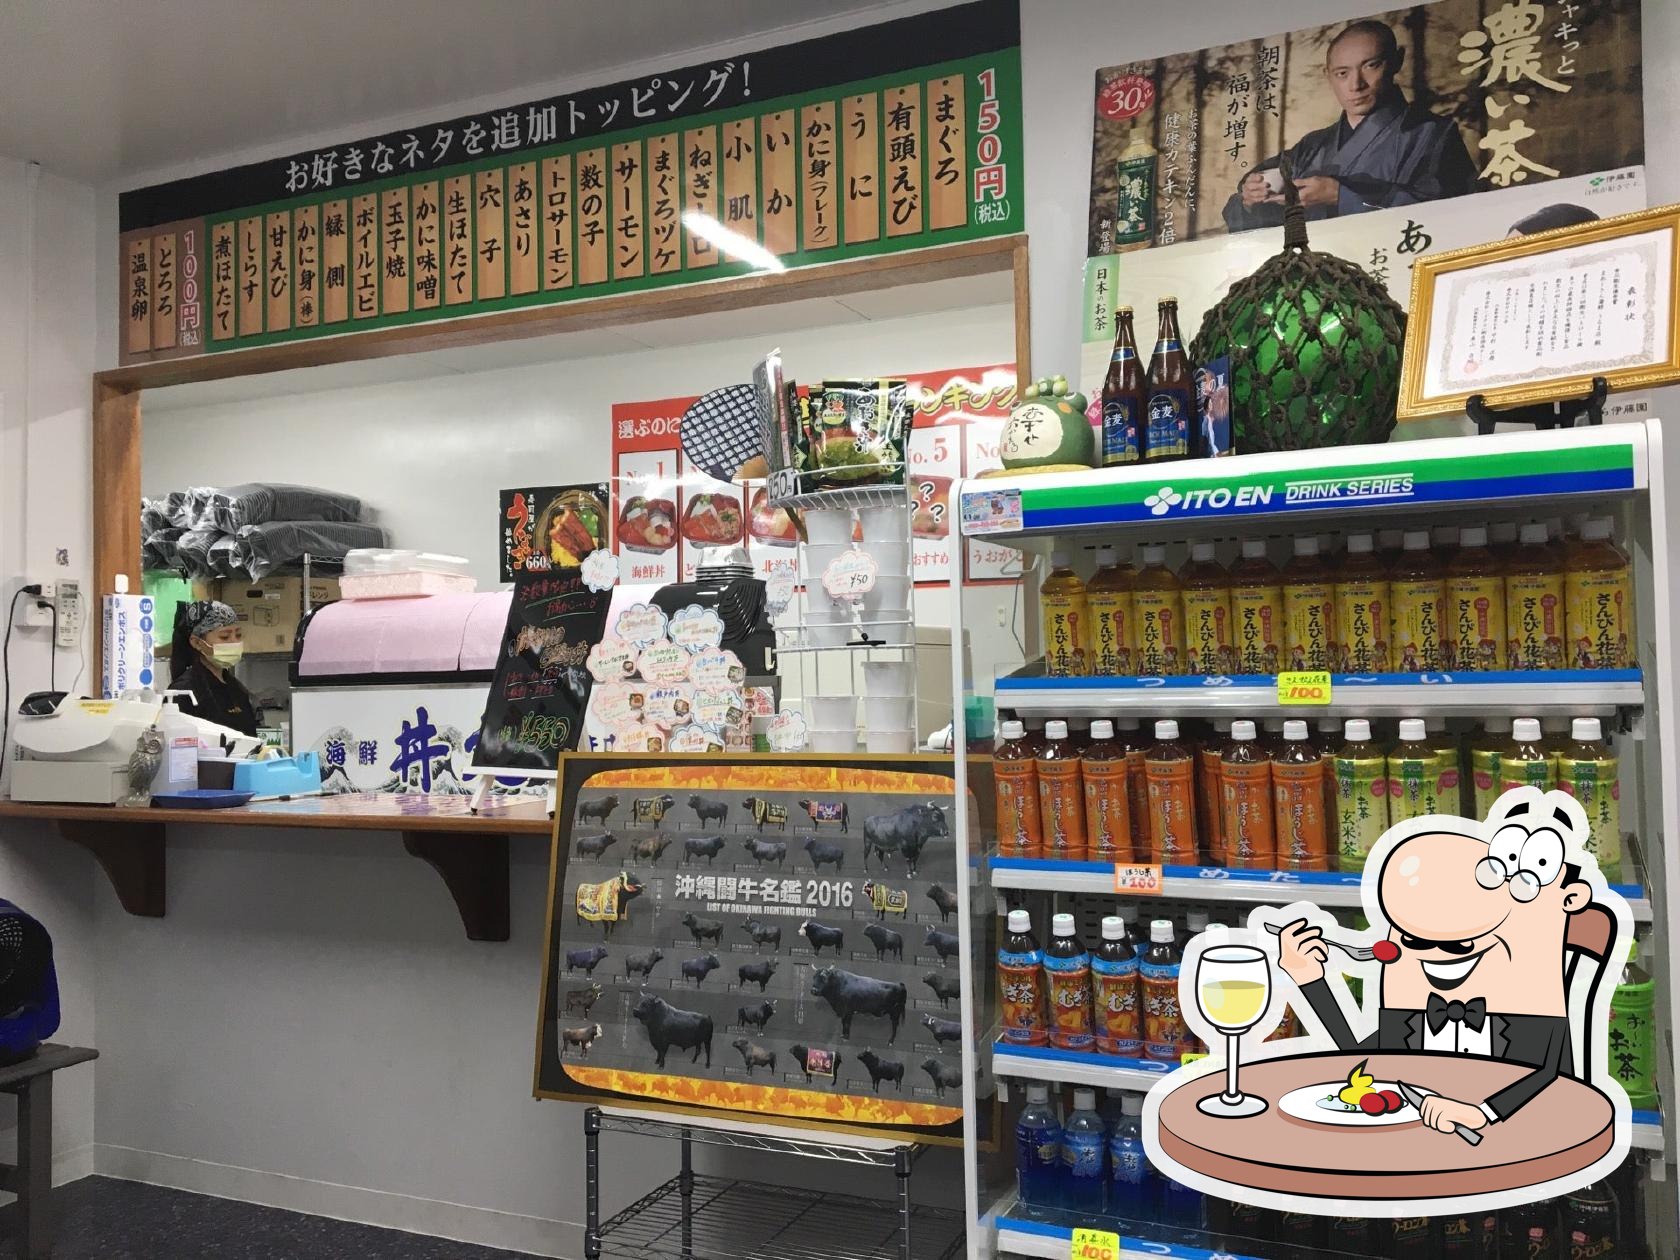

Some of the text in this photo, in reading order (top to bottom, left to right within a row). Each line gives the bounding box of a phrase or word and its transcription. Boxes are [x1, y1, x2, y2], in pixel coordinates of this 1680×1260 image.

[1554, 0, 1581, 75] ャキっと
[1223, 73, 1250, 169] 福が増す。
[1256, 46, 1280, 118] 朝茶は、
[1457, 0, 1573, 187] 濃い茶
[285, 61, 751, 193] お好きなネタを追加トッピング!
[850, 111, 873, 201] うに
[888, 102, 917, 225] 有頭えび
[934, 94, 960, 186] まぐろ
[973, 68, 1008, 202] 150円
[580, 164, 605, 247] 数の子
[614, 157, 641, 269] サーモン
[653, 149, 676, 273] まぐろヅケ
[766, 131, 793, 215] いか
[973, 198, 1010, 226] (税込)
[1158, 112, 1183, 245] 健康カテキン2倍
[386, 203, 406, 279] 玉子焼
[415, 198, 438, 301] かに味噌
[447, 190, 467, 295] 生ほたて
[479, 183, 502, 264] 穴子
[513, 178, 534, 257] あさり
[547, 170, 569, 284] トロサーモン
[130, 254, 149, 321] 温泉卵
[157, 247, 174, 317] とろろ
[180, 230, 200, 330] 100円
[213, 236, 232, 332] 煮ほたて
[243, 231, 259, 303] しらす
[268, 227, 289, 299] 甘えび
[356, 206, 375, 313] ボイルエビ
[1095, 268, 1109, 332] 日本のお茶
[910, 384, 1018, 414] ンキン
[1151, 404, 1174, 420] 金麦
[933, 438, 949, 463] 5
[1181, 475, 1414, 511] ITO EN DRINK SERIES
[912, 553, 949, 567] おすすめ
[1341, 808, 1358, 857] 玄米茶
[675, 874, 853, 907] 沖縄闘牛名鑑 2016
[706, 902, 721, 912] LIST
[722, 903, 731, 913] OF
[731, 904, 763, 914] OKINAWA
[795, 907, 817, 918] BULLS
[1609, 1028, 1644, 1081] お茶
